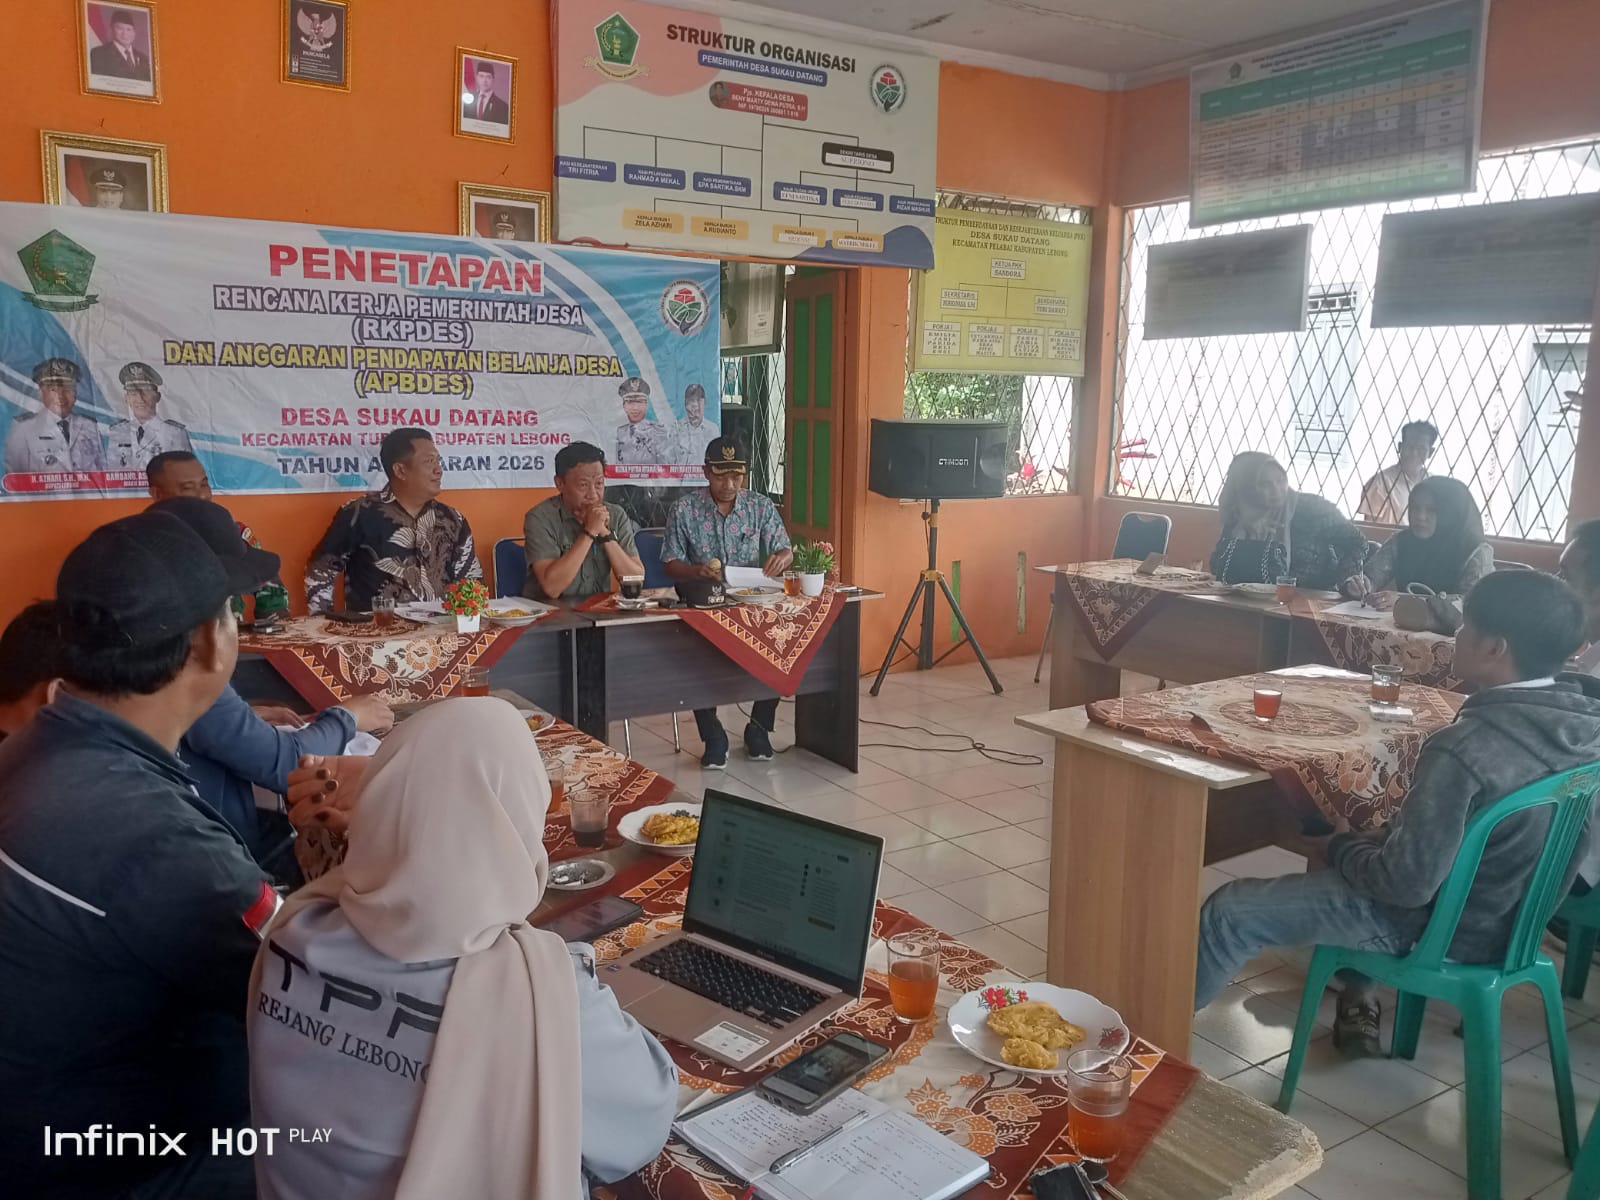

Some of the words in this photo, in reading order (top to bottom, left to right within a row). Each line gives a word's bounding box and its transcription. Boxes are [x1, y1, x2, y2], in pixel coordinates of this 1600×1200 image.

[667, 24, 755, 54] STRUKTUR
[760, 42, 856, 72] ORGANISASI
[702, 55, 749, 70] PEMERINTAH
[750, 62, 769, 73] DESA
[771, 66, 795, 78] SUKAU
[796, 71, 823, 83] DATANG
[755, 90, 778, 99] KEPALA
[779, 93, 795, 102] DESA
[580, 168, 599, 176] FITRIA
[629, 174, 654, 182] RAHMAD
[651, 221, 672, 229] AZHARI
[936, 217, 959, 225] TRUKTUR
[952, 239, 988, 249] KECAMATAN
[971, 231, 990, 240] DESA
[993, 233, 1018, 242] SUKAU
[1021, 236, 1050, 246] DATANG
[269, 244, 542, 292] PENETAPAN
[994, 270, 1022, 278] SANDORA
[944, 291, 975, 299] SEKRETARIS
[213, 285, 328, 314] RENCANA
[329, 290, 403, 319] KERJA
[405, 296, 532, 324] PEMERINTAH
[534, 302, 585, 326] DESA
[352, 319, 473, 348] (RKPDES)
[163, 340, 214, 366] DAN
[219, 342, 348, 370] ANGGARAN
[352, 346, 482, 373] PENDAPATAN
[487, 350, 572, 376] BELANJA
[573, 354, 623, 378] DESA
[354, 370, 474, 400] (APBDES)
[280, 407, 348, 428] DESA
[357, 408, 440, 426] SUKAU
[449, 409, 538, 427] DATANG
[242, 433, 351, 447] KECAMATAN
[435, 433, 507, 446] BUPATEN
[511, 432, 571, 445] LEBONG
[277, 456, 359, 475] TAHUN
[368, 456, 491, 472] AARAN
[498, 456, 545, 471] 2026
[259, 992, 336, 1046] REJANG
